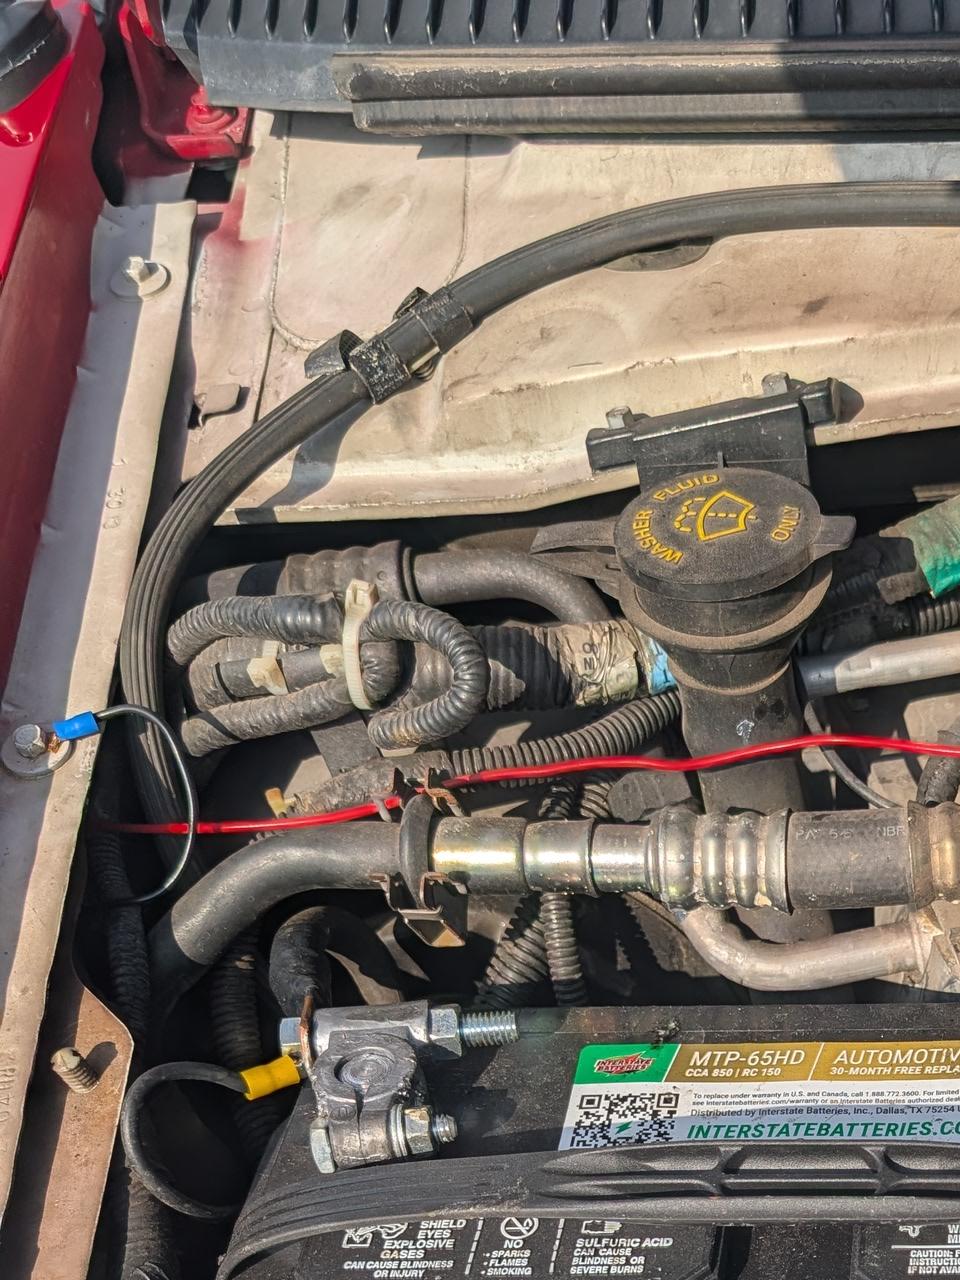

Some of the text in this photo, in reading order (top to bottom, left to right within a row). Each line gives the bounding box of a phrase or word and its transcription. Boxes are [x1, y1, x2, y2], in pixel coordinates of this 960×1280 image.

[652, 473, 720, 501] FLUID
[770, 504, 800, 542] ONLY
[632, 509, 684, 565] WASHER
[689, 1050, 805, 1066] MTP-65HD
[685, 1068, 709, 1077] CCA
[711, 1068, 733, 1077] 850
[741, 1068, 758, 1077] RC
[761, 1067, 781, 1076] 150
[830, 1066, 893, 1075] 30-MONTH
[894, 1066, 922, 1075] FREE
[703, 1092, 729, 1100] replace
[875, 1097, 905, 1105] Batteries
[691, 1108, 742, 1117] Distributed
[745, 1108, 756, 1118] by
[758, 1107, 804, 1116] Interstate
[806, 1106, 851, 1116] Batteries,
[853, 1107, 873, 1116] Inc.,
[875, 1106, 908, 1115] Dallas,
[911, 1106, 923, 1114] TX
[925, 1105, 955, 1114] 75254
[420, 1219, 467, 1229] SHIELD
[417, 1229, 452, 1239] EYES
[383, 1239, 456, 1250] EXPLOSIVE
[503, 1239, 524, 1249] NO
[575, 1237, 673, 1248] SULFURIC ACID
[380, 1249, 425, 1259] GASES
[491, 1249, 531, 1258] SPARKS
[573, 1247, 632, 1256] CAN CAUSE
[910, 1249, 954, 1258] CAUTION:
[343, 1259, 454, 1270] CAN CAUSE BLINDNESS
[489, 1258, 528, 1267] FLAMES
[571, 1256, 645, 1265] BLINDNESS OR
[373, 1269, 426, 1278] OR INJURY
[486, 1267, 532, 1276] SMOKING
[570, 1264, 644, 1274] SEVERE BURNS
[907, 1265, 918, 1274] IF
[919, 1265, 939, 1274] NOT
